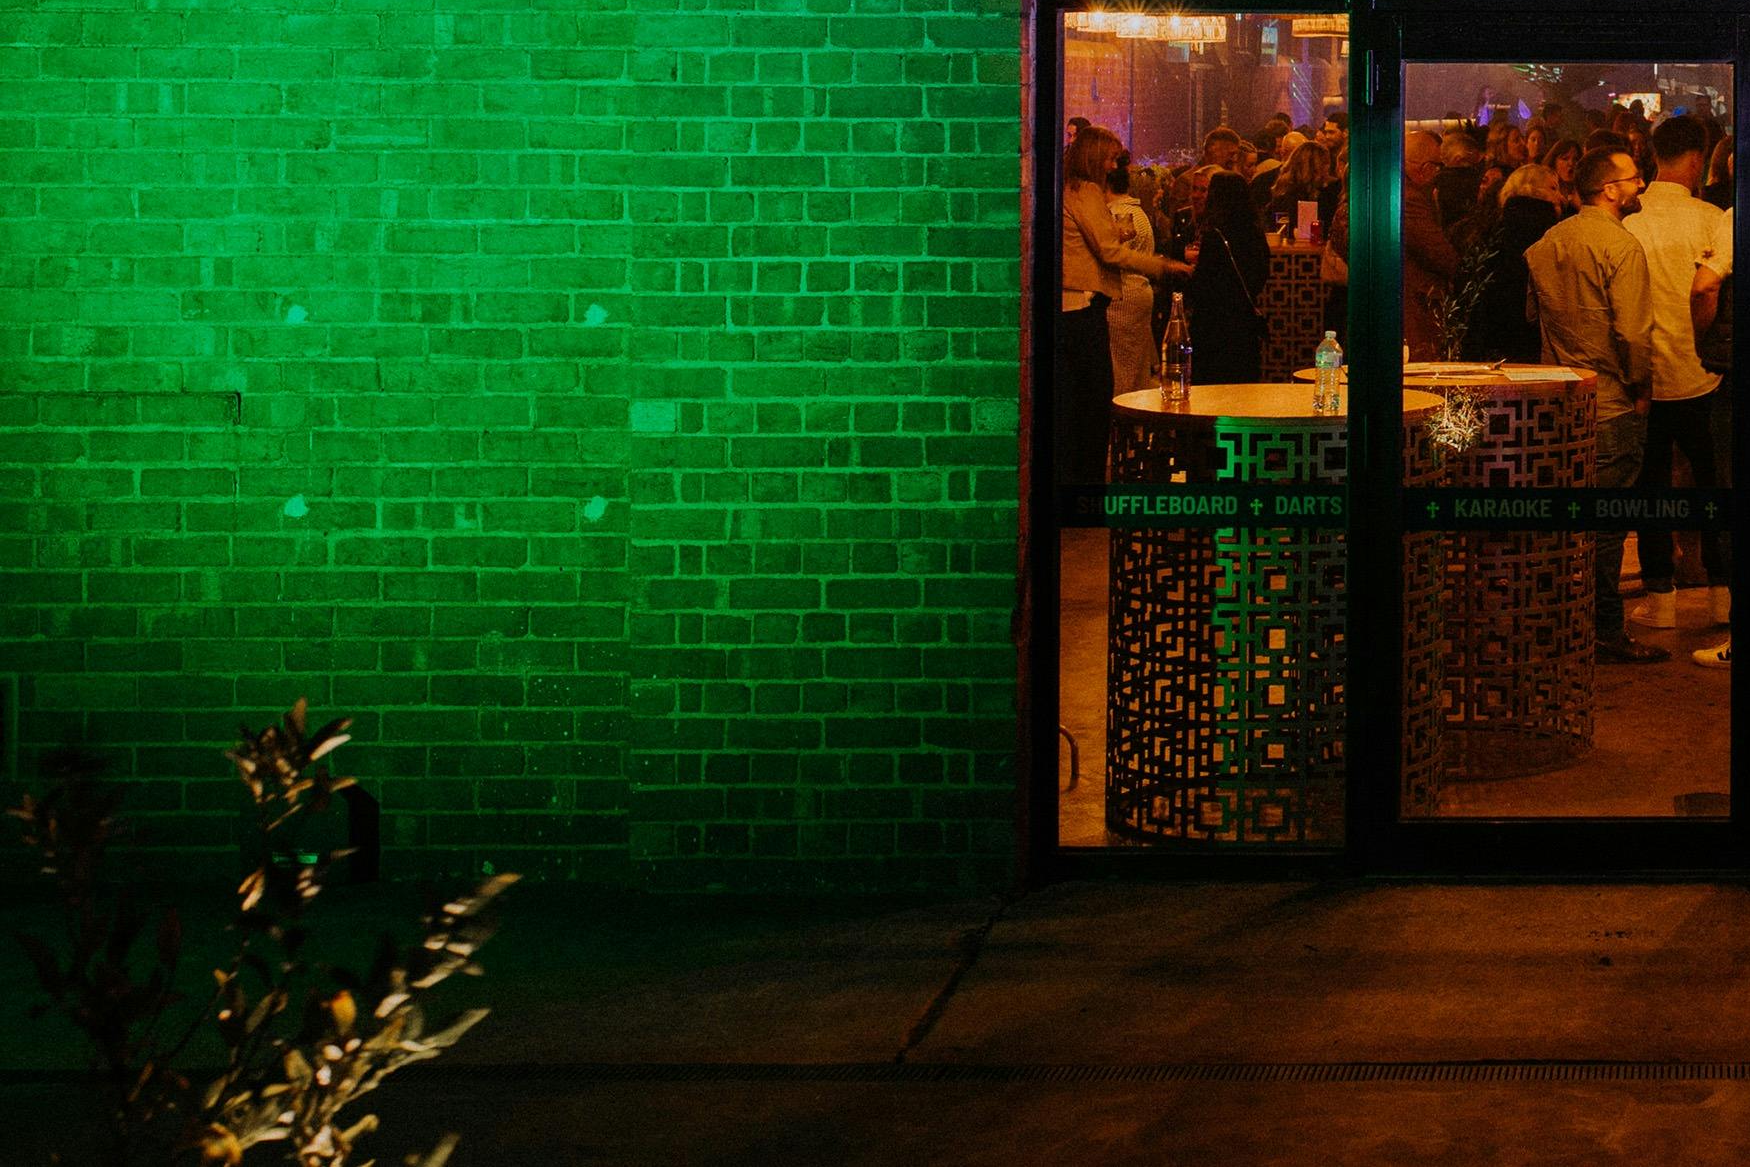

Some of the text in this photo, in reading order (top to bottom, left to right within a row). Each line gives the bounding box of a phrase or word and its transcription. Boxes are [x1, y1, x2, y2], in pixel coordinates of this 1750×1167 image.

[1275, 495, 1343, 515] DARTS
[1454, 498, 1690, 519] KARAOKE BOWLING
